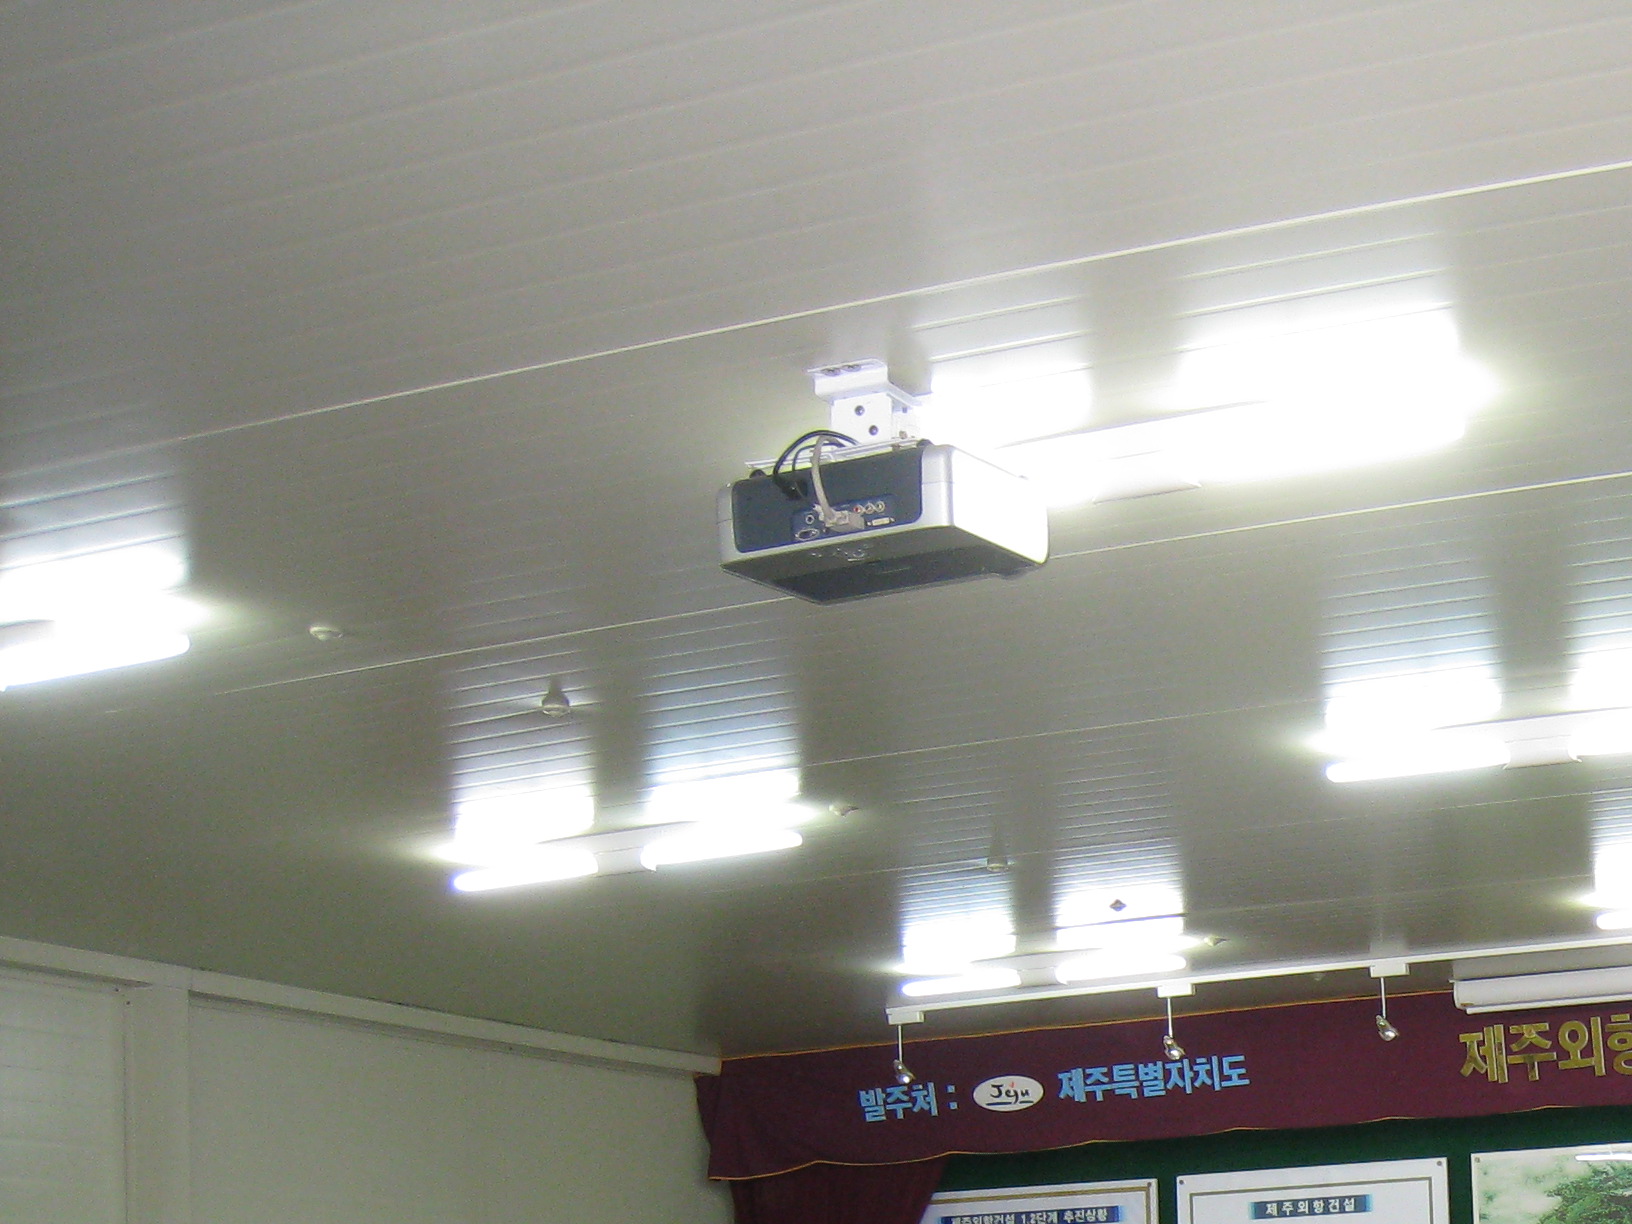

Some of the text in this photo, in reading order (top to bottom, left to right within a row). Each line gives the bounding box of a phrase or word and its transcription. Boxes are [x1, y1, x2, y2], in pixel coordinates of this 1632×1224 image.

[858, 1082, 938, 1122] 발주처
[988, 1081, 1031, 1104] Jeju
[1057, 1055, 1251, 1102] 제주특별자치도
[1063, 1208, 1108, 1223] 추진상황
[1265, 1197, 1356, 1216] 제주외항건설
